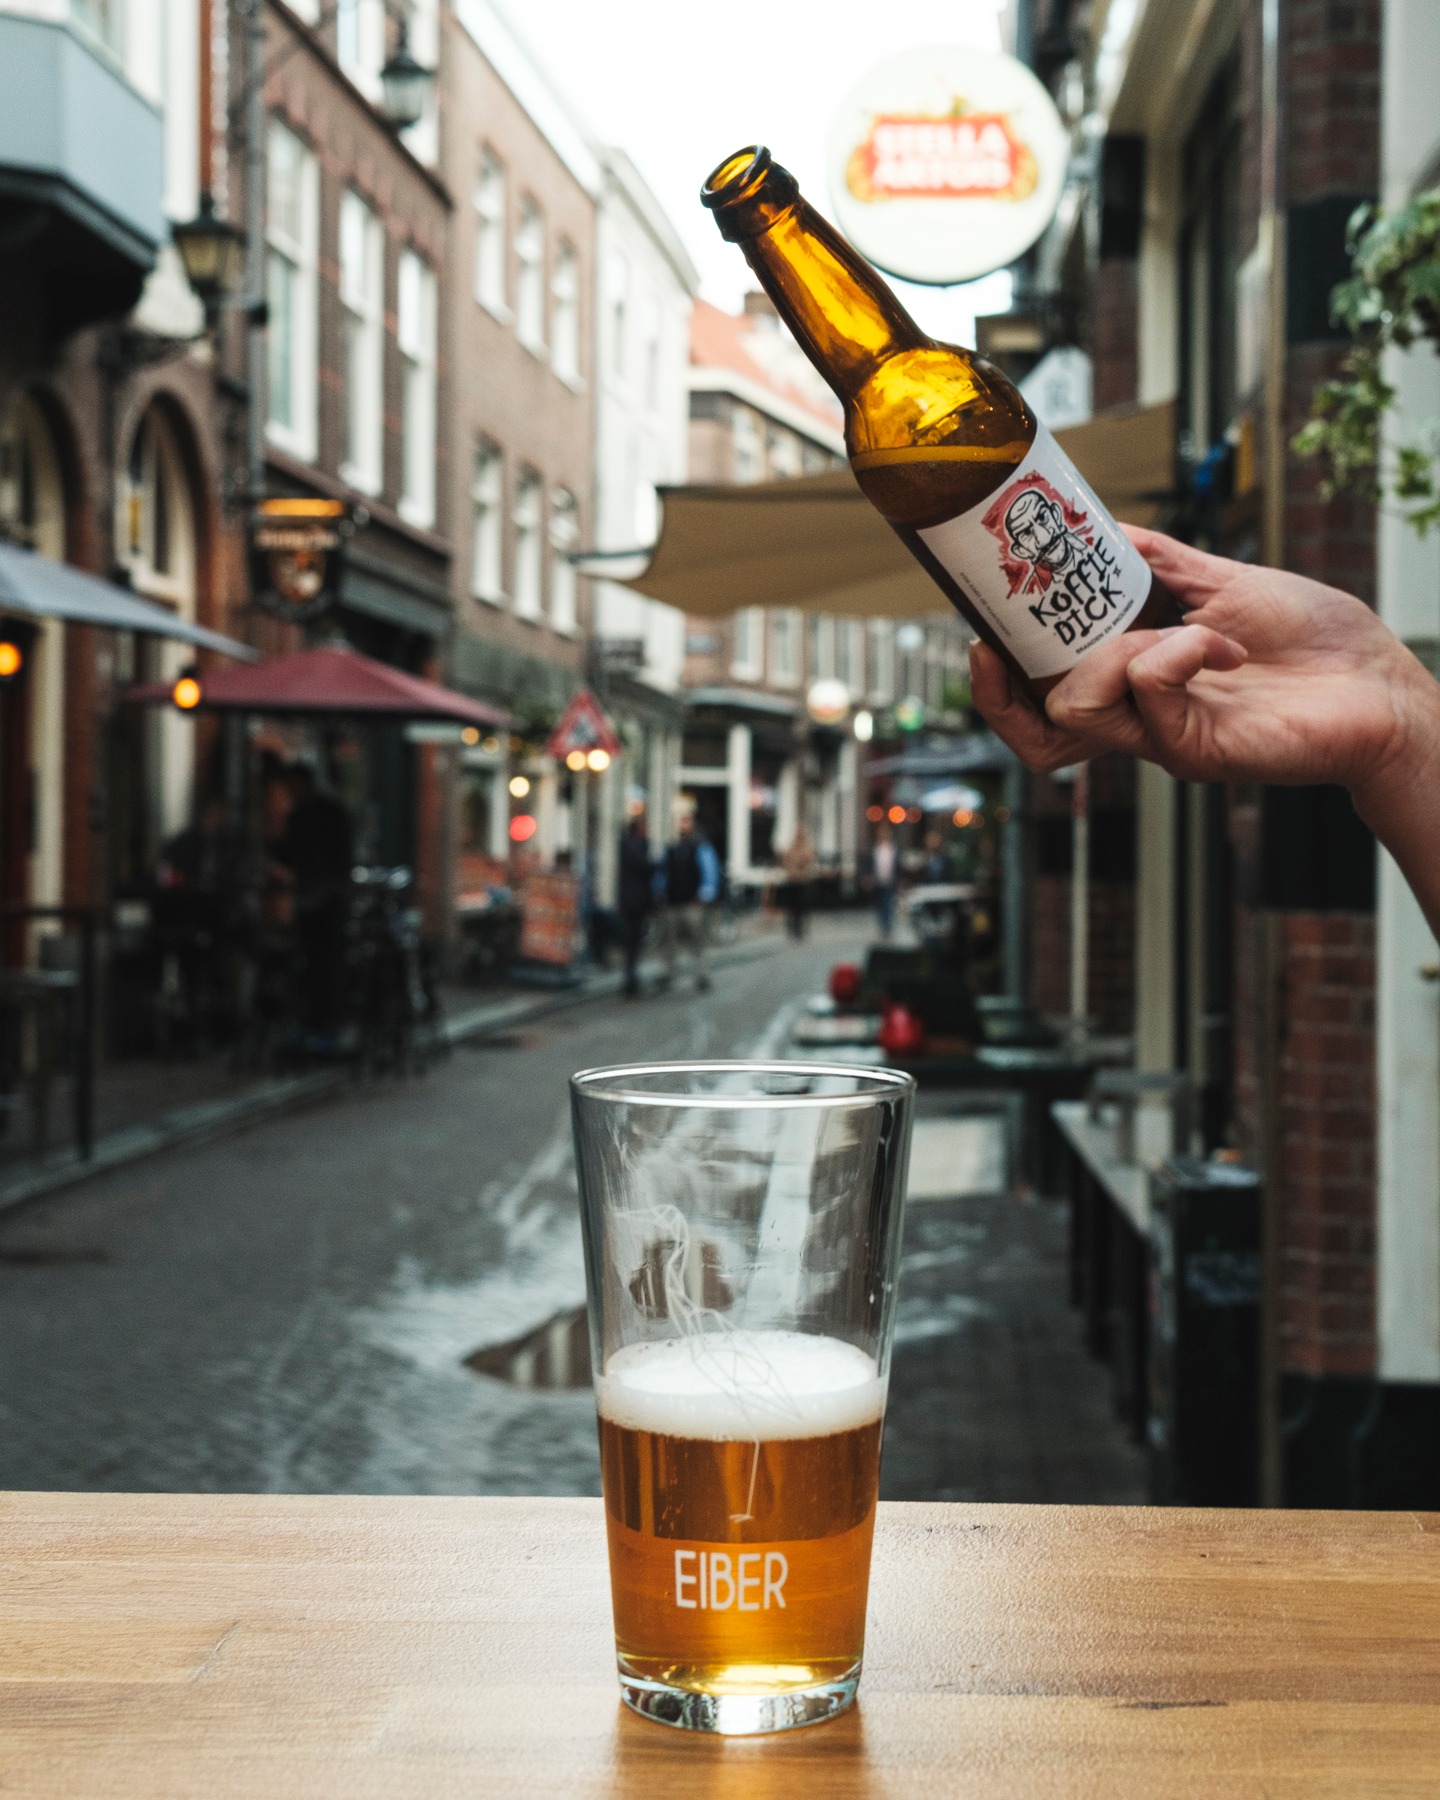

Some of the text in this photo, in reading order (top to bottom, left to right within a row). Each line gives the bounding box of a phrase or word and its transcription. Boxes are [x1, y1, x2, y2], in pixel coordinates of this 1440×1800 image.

[1029, 536, 1115, 627] KOFFIE
[1054, 573, 1123, 646] DICK
[1075, 633, 1105, 655] BRANDEN
[1104, 625, 1113, 635] EN
[674, 1549, 789, 1611] EIBER
